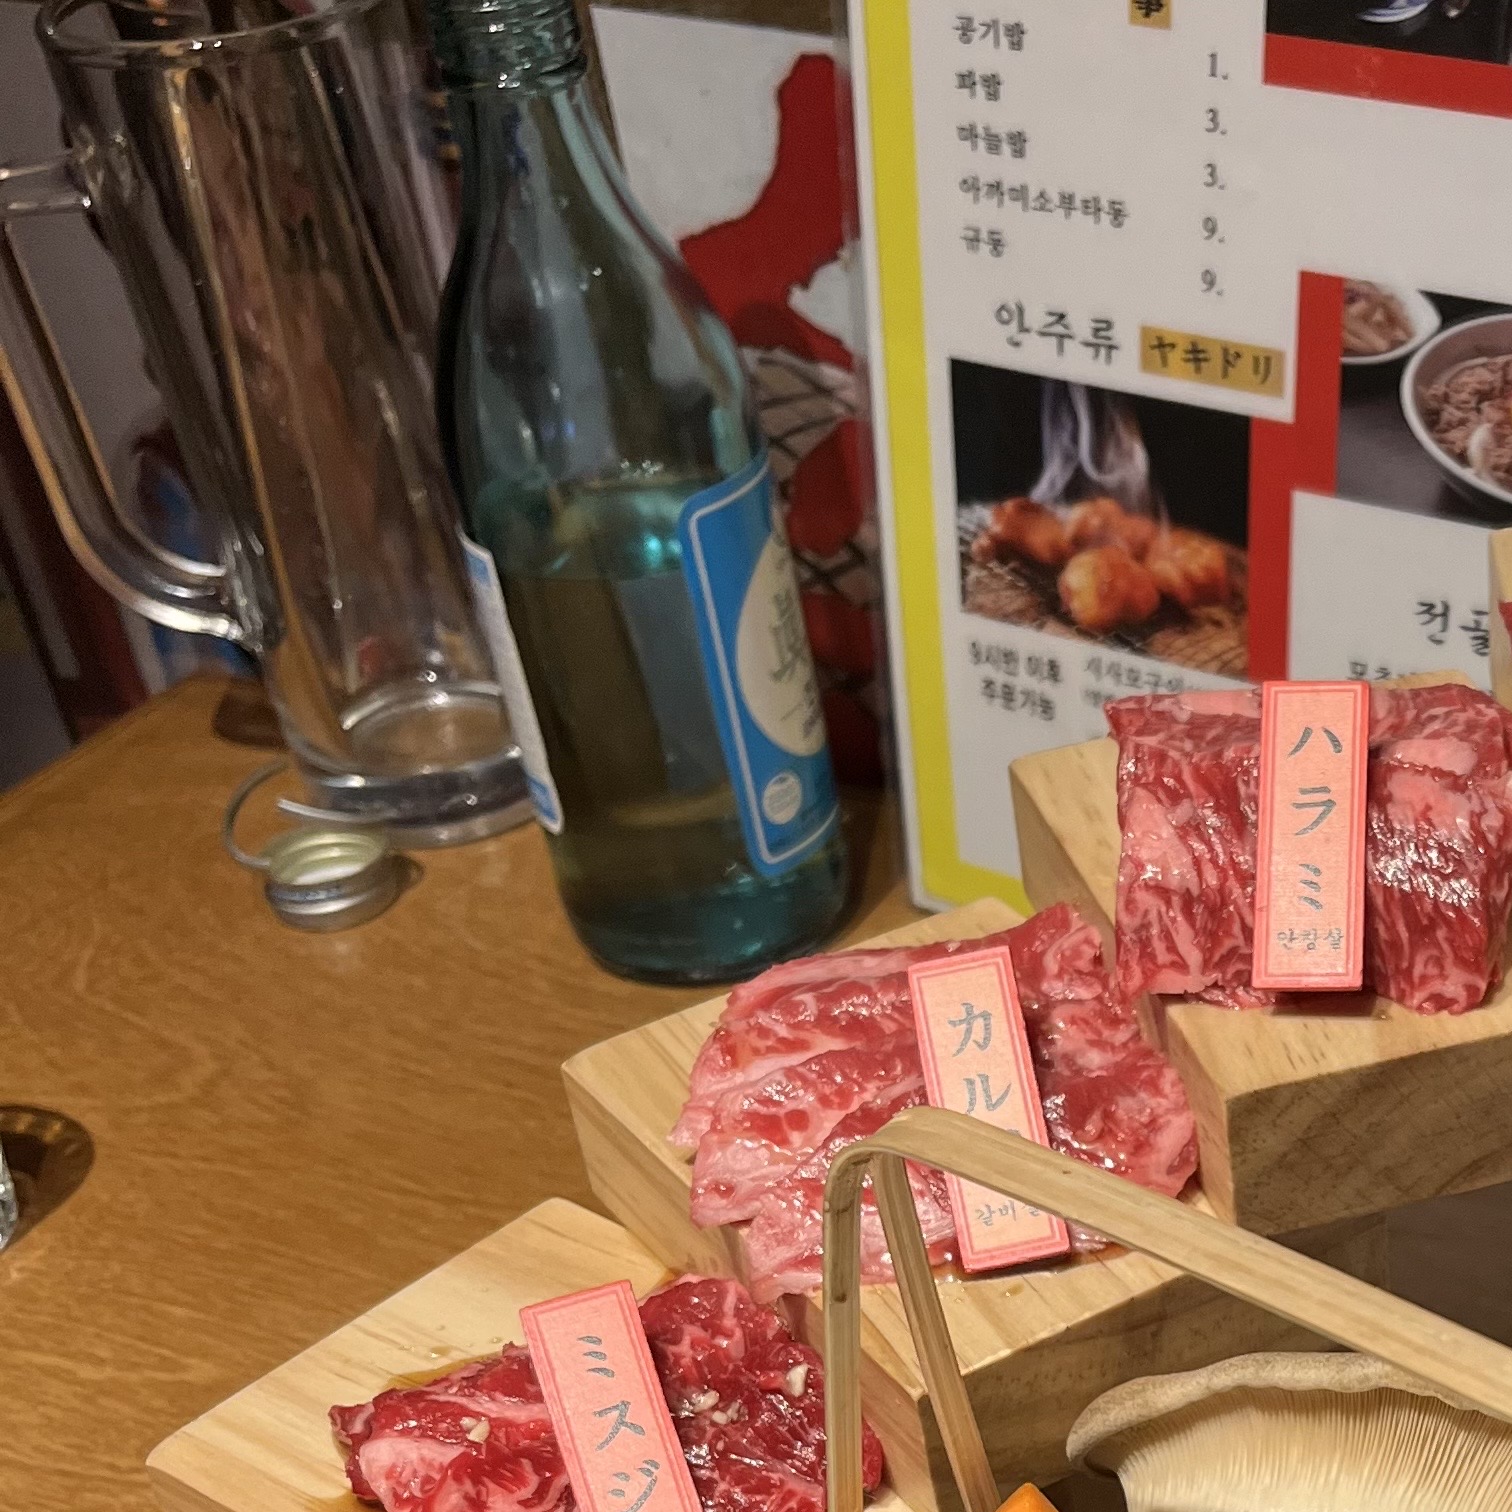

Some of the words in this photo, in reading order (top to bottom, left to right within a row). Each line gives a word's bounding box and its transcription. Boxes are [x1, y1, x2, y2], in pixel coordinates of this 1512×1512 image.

[953, 15, 1028, 52] 공기밥
[1207, 52, 1230, 81] 1.
[1204, 107, 1228, 136] 3.
[956, 121, 1030, 159] 마늘밥
[1203, 162, 1227, 191] 3.
[1201, 216, 1226, 244] 9.
[1200, 269, 1225, 296] 9.
[994, 300, 1121, 366] 안주류
[1149, 335, 1274, 386] ヤキドリ
[1287, 726, 1343, 912] ハラミ
